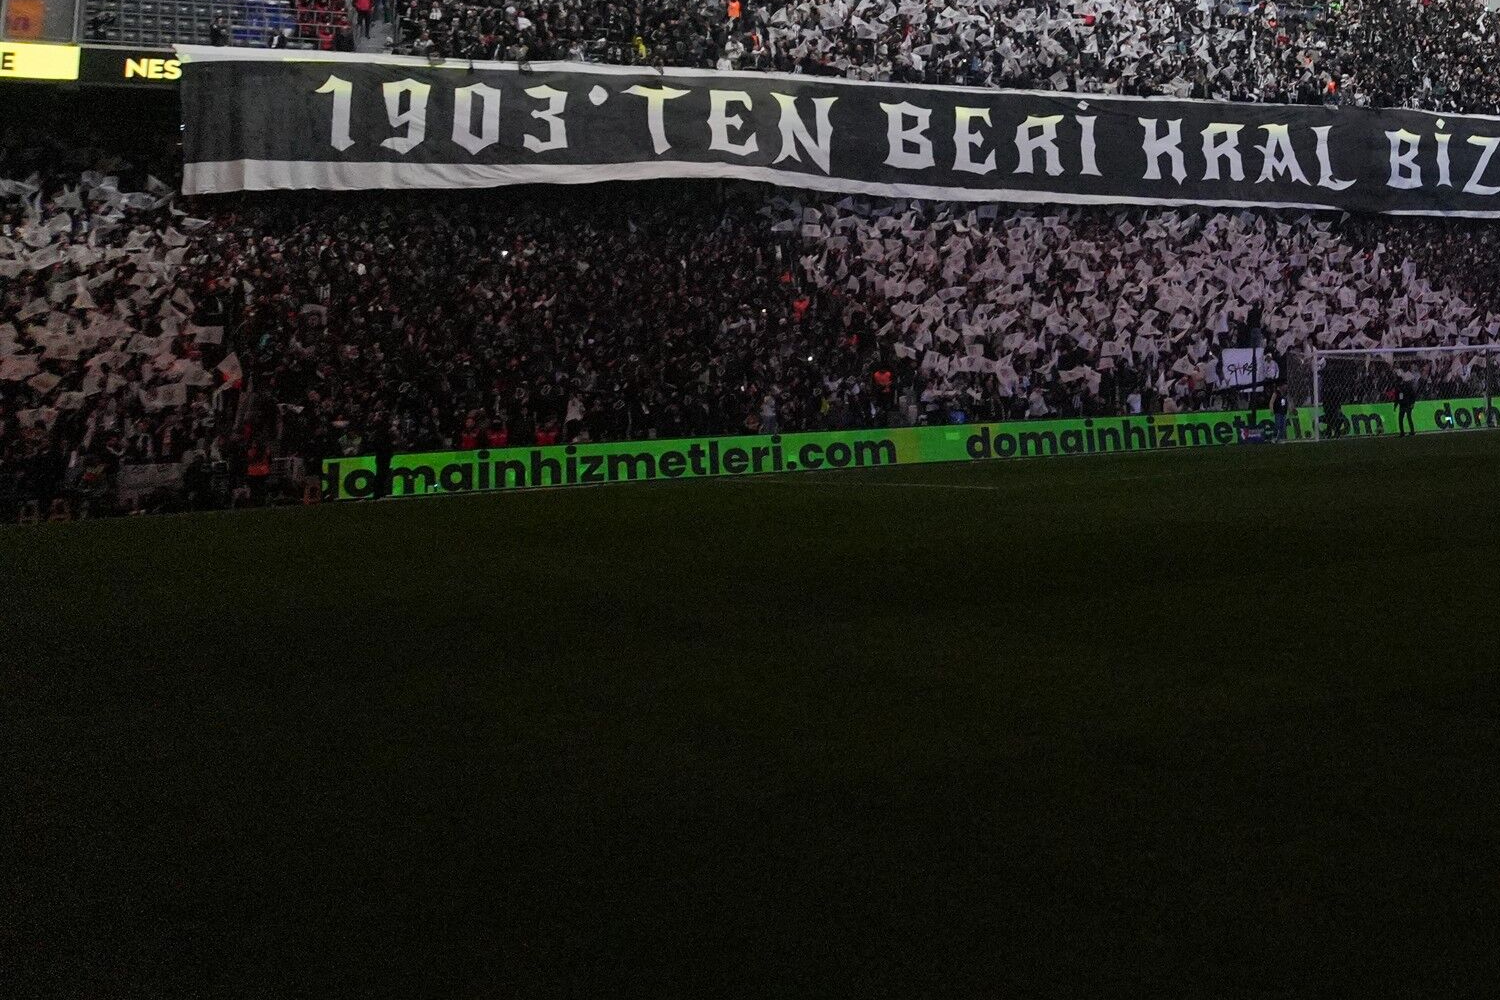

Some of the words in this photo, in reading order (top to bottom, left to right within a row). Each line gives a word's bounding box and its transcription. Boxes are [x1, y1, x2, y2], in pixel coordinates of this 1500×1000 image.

[125, 57, 183, 80] NES
[879, 100, 1102, 177] BERİ
[1138, 116, 1356, 191] KRAL
